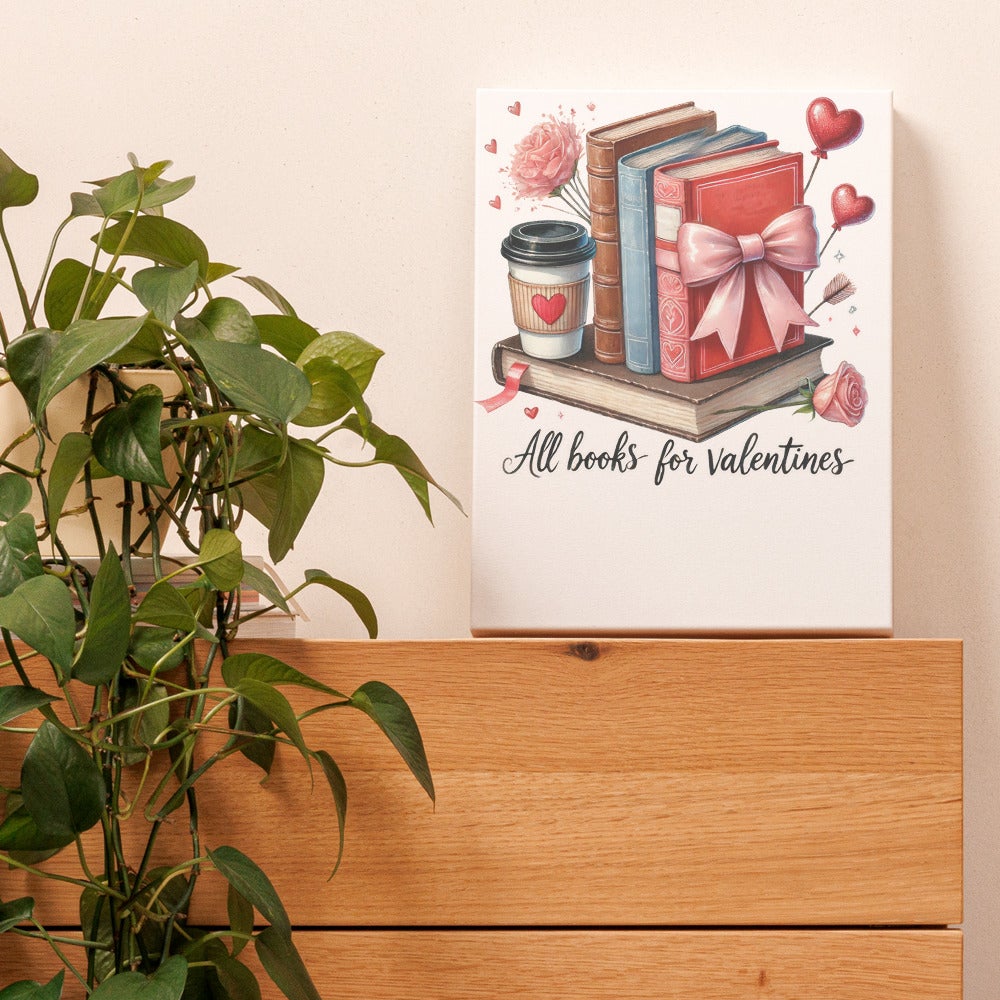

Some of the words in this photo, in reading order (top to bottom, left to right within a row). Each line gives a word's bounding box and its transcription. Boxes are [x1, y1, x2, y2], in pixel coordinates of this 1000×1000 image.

[502, 428, 563, 478] All
[566, 430, 649, 473] books
[653, 439, 698, 486] for
